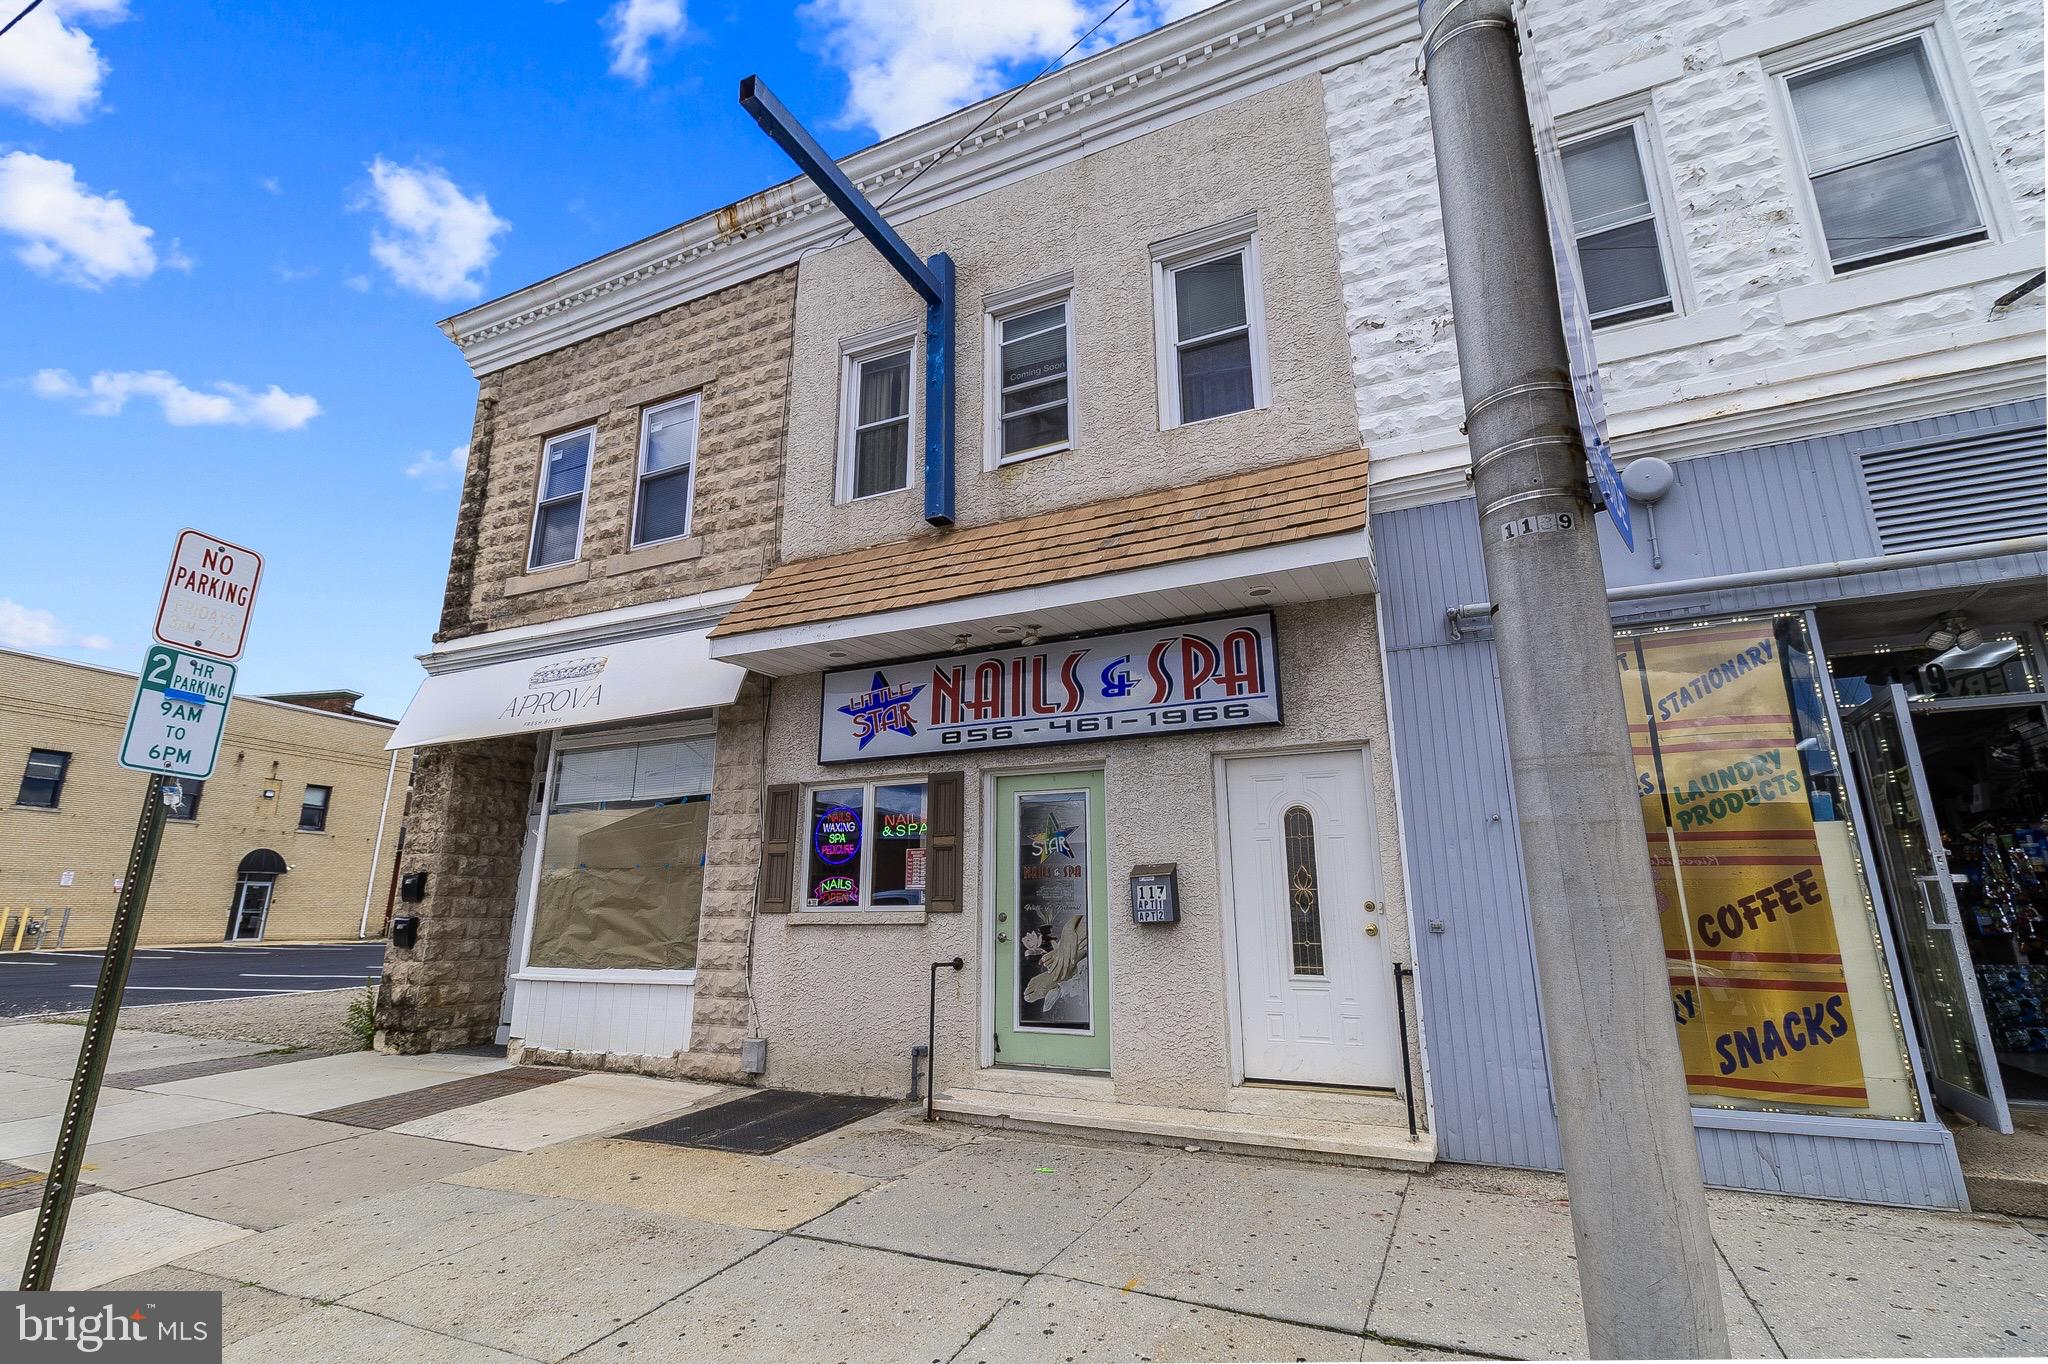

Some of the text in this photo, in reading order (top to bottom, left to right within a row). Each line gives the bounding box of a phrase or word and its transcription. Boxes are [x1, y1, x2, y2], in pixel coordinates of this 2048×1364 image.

[1010, 361, 1065, 381] Coming Soon
[202, 548, 234, 576] NO
[174, 566, 249, 607] PARKING
[147, 653, 214, 685] 2 HR
[930, 627, 1266, 725] NAILS & SPA
[1657, 638, 1775, 721] STATIONARY
[173, 675, 225, 699] PARKING
[850, 681, 913, 711] LITTLE
[160, 701, 203, 724] 9AM
[852, 703, 918, 738] STAR
[941, 703, 1250, 745] 856-461-1966
[166, 724, 186, 741] TO
[148, 744, 192, 765] 6PM
[1673, 748, 1782, 806] LAUNDRY
[1676, 769, 1801, 832] PRODUCTS
[822, 821, 856, 833] WAXING
[828, 833, 846, 844] SPA
[1031, 836, 1070, 857] STAR
[821, 878, 852, 892] NAILS
[1138, 885, 1165, 900] 117
[1138, 899, 1163, 910] APT 1
[1139, 910, 1164, 922] APT 2
[1697, 868, 1824, 948] COFFEE
[1715, 995, 1849, 1076] SNACKS
